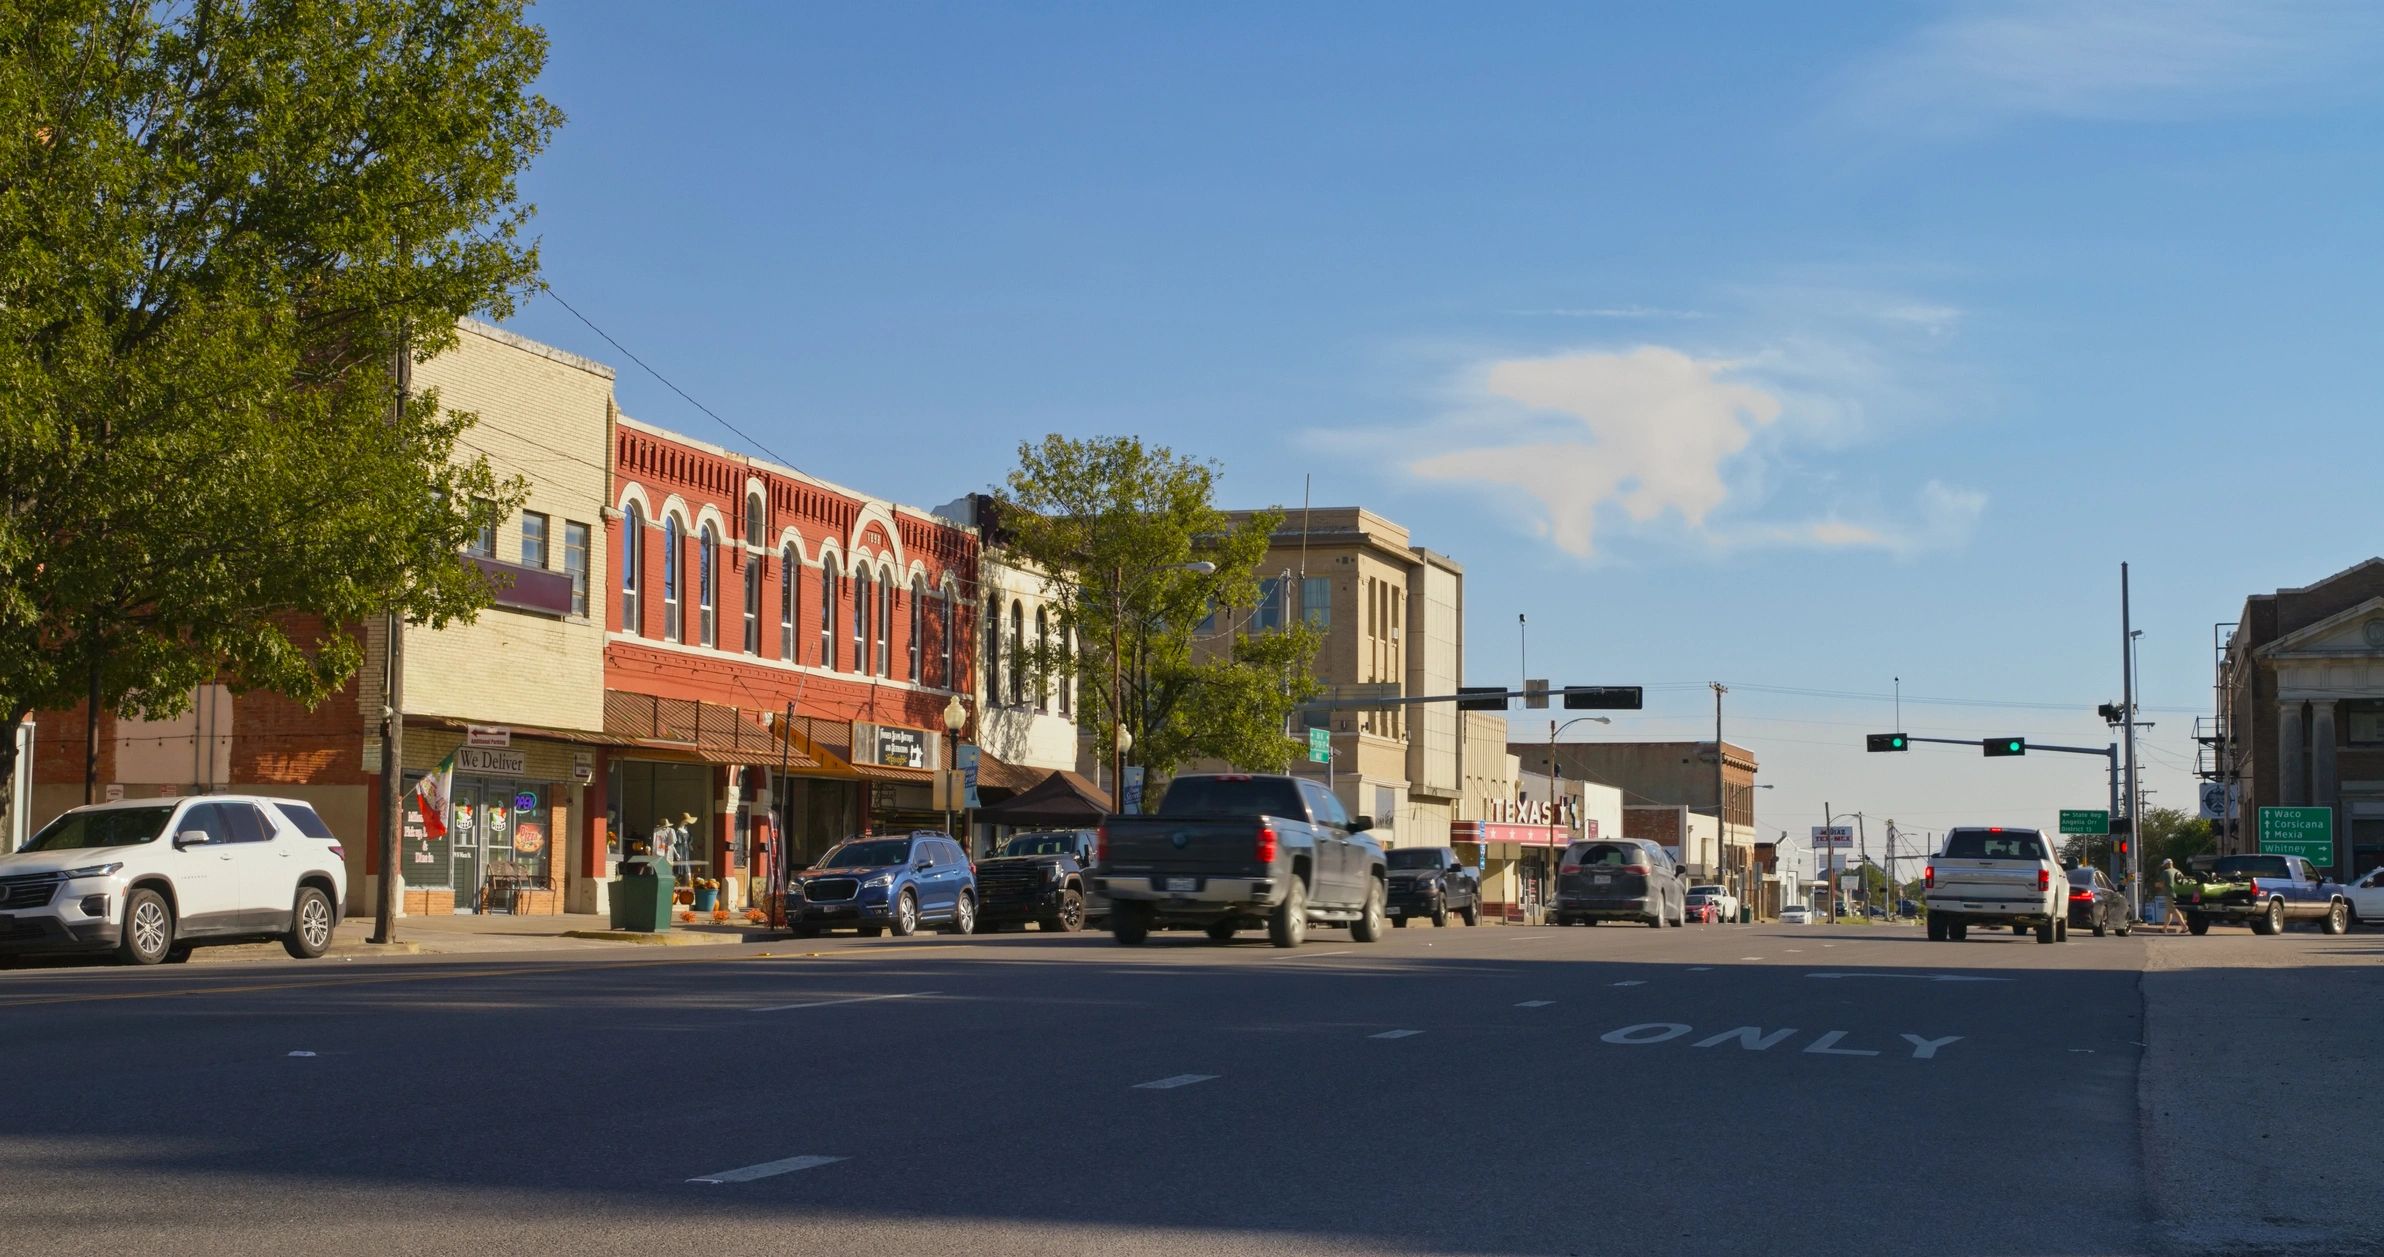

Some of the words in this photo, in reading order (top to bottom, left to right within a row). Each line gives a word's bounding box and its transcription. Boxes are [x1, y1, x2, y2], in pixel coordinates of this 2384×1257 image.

[461, 750, 478, 768] We
[482, 751, 523, 770] Deliver
[1493, 799, 1551, 824] TEXAS
[2274, 810, 2301, 818] Waco
[2274, 820, 2324, 829] Corsicana
[2274, 831, 2303, 839] Mexia
[2265, 844, 2306, 855] Whitney
[1600, 1023, 1965, 1058] ONLY
